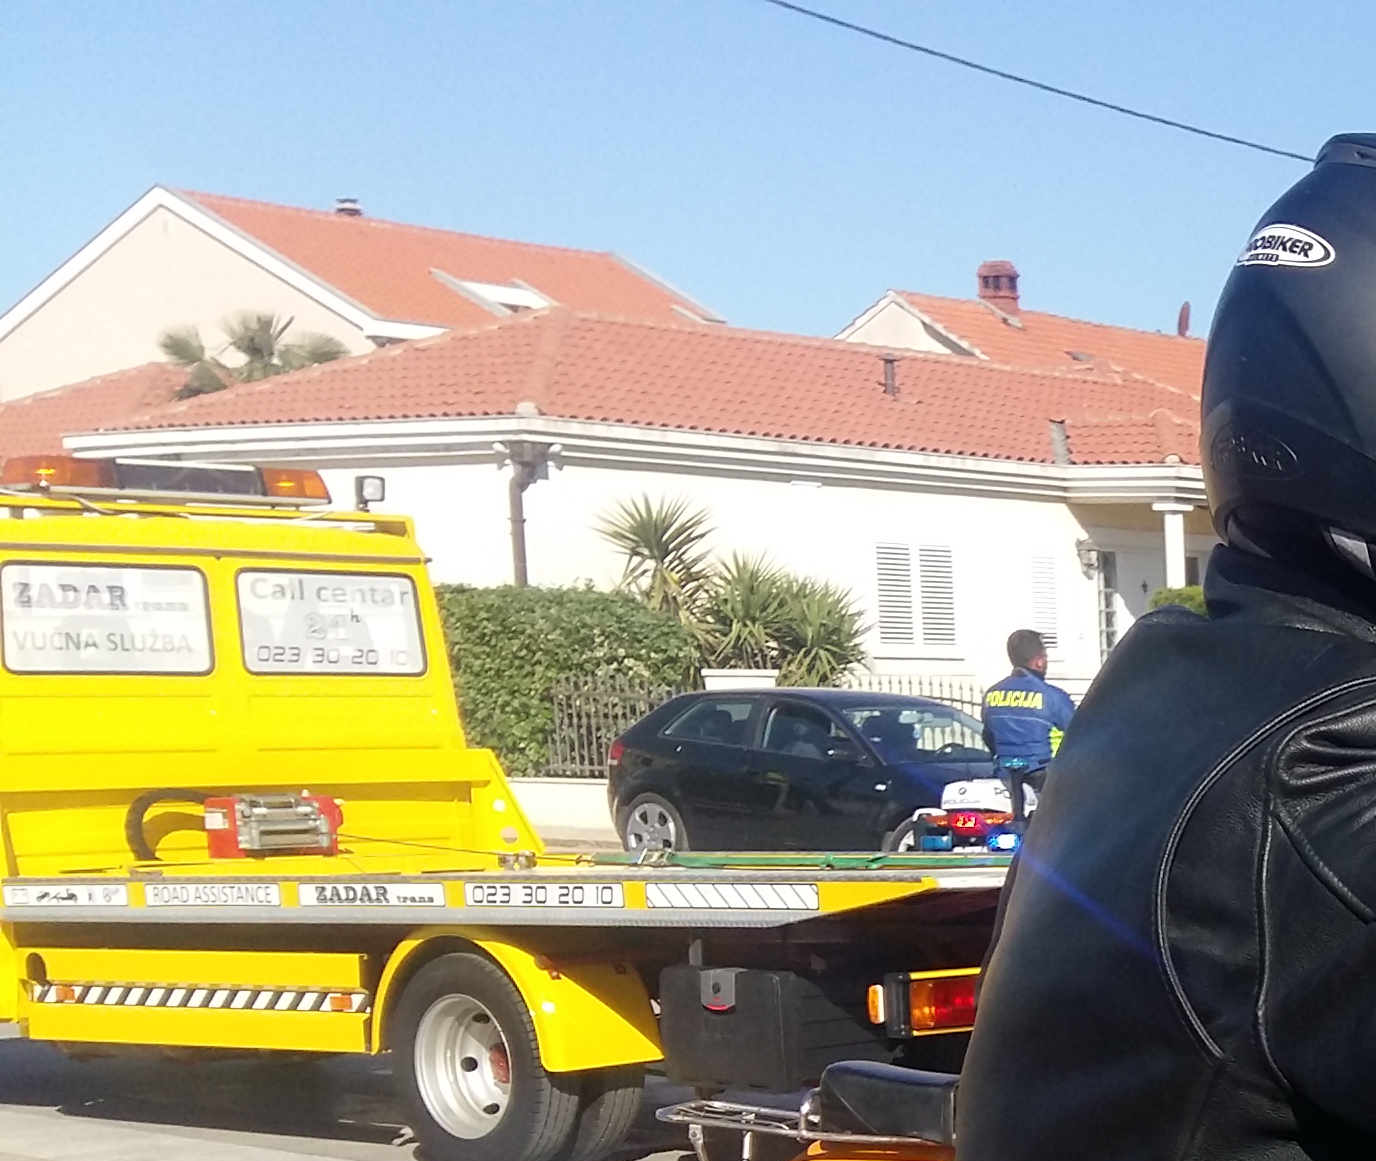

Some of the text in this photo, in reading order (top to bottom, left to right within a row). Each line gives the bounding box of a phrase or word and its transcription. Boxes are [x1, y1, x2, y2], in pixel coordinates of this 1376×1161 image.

[13, 582, 129, 611] ZADAR
[249, 577, 409, 606] Call centar
[106, 629, 194, 653] SLUŽBA
[257, 645, 408, 666] 023 30 20 10
[986, 690, 1043, 710] POLICIJA
[152, 886, 273, 904] ROAD ASSISTANCE
[315, 885, 435, 905] ZADAR trans
[472, 885, 614, 905] 023 30 20 10
